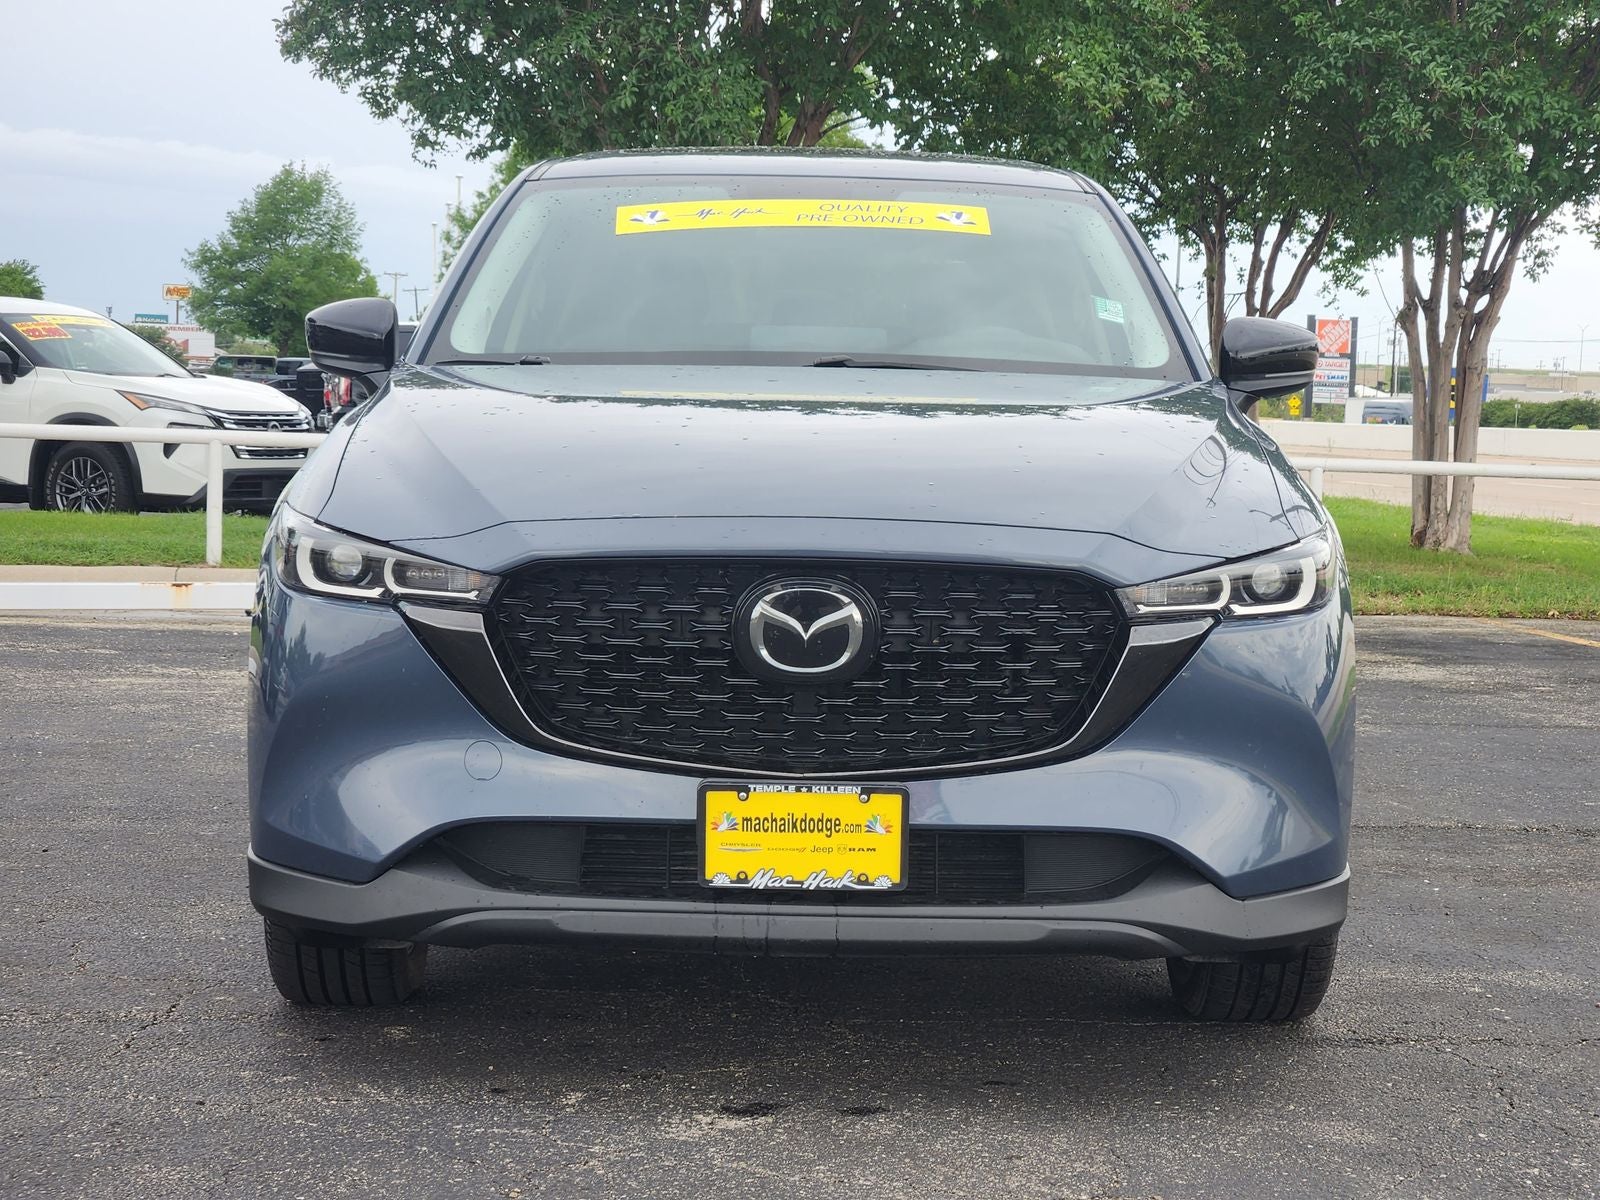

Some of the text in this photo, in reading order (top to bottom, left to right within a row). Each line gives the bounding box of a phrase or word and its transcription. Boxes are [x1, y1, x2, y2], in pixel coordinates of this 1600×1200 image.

[819, 203, 908, 213] QUALITY
[796, 214, 924, 225] PRE-OWNED
[1325, 360, 1348, 368] TARGET
[748, 784, 861, 794] TEMPLE KILLEEN
[741, 812, 862, 838] machaikdodge.com
[810, 845, 834, 854] Jeep
[749, 868, 858, 890] Mac Haik
